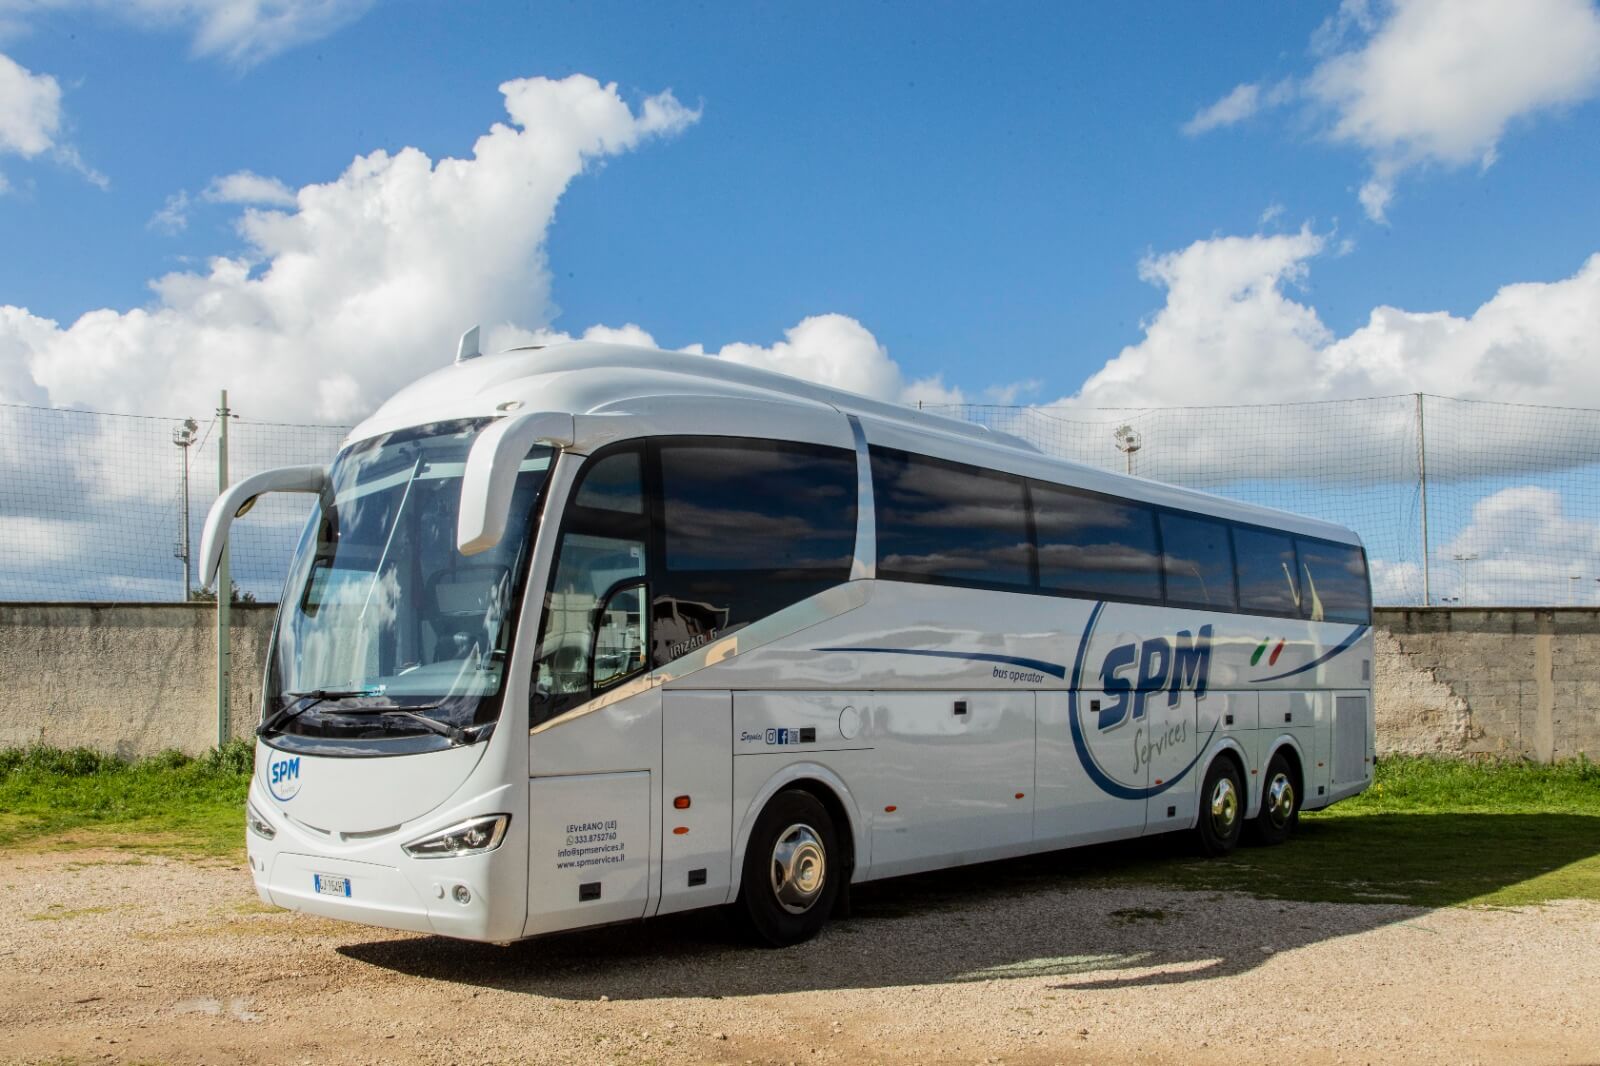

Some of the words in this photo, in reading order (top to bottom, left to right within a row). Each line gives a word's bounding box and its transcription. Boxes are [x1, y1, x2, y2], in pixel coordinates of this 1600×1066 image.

[670, 634, 705, 658] IRIZAR
[993, 665, 1008, 680] bus
[1009, 671, 1045, 683] operator
[1098, 623, 1214, 732] SPM
[1133, 719, 1188, 775] Services
[272, 757, 300, 784] SPM
[566, 822, 604, 833] LEVERANO
[557, 843, 625, 858] info@spmservices.it
[556, 854, 625, 869] www.spmservices.it
